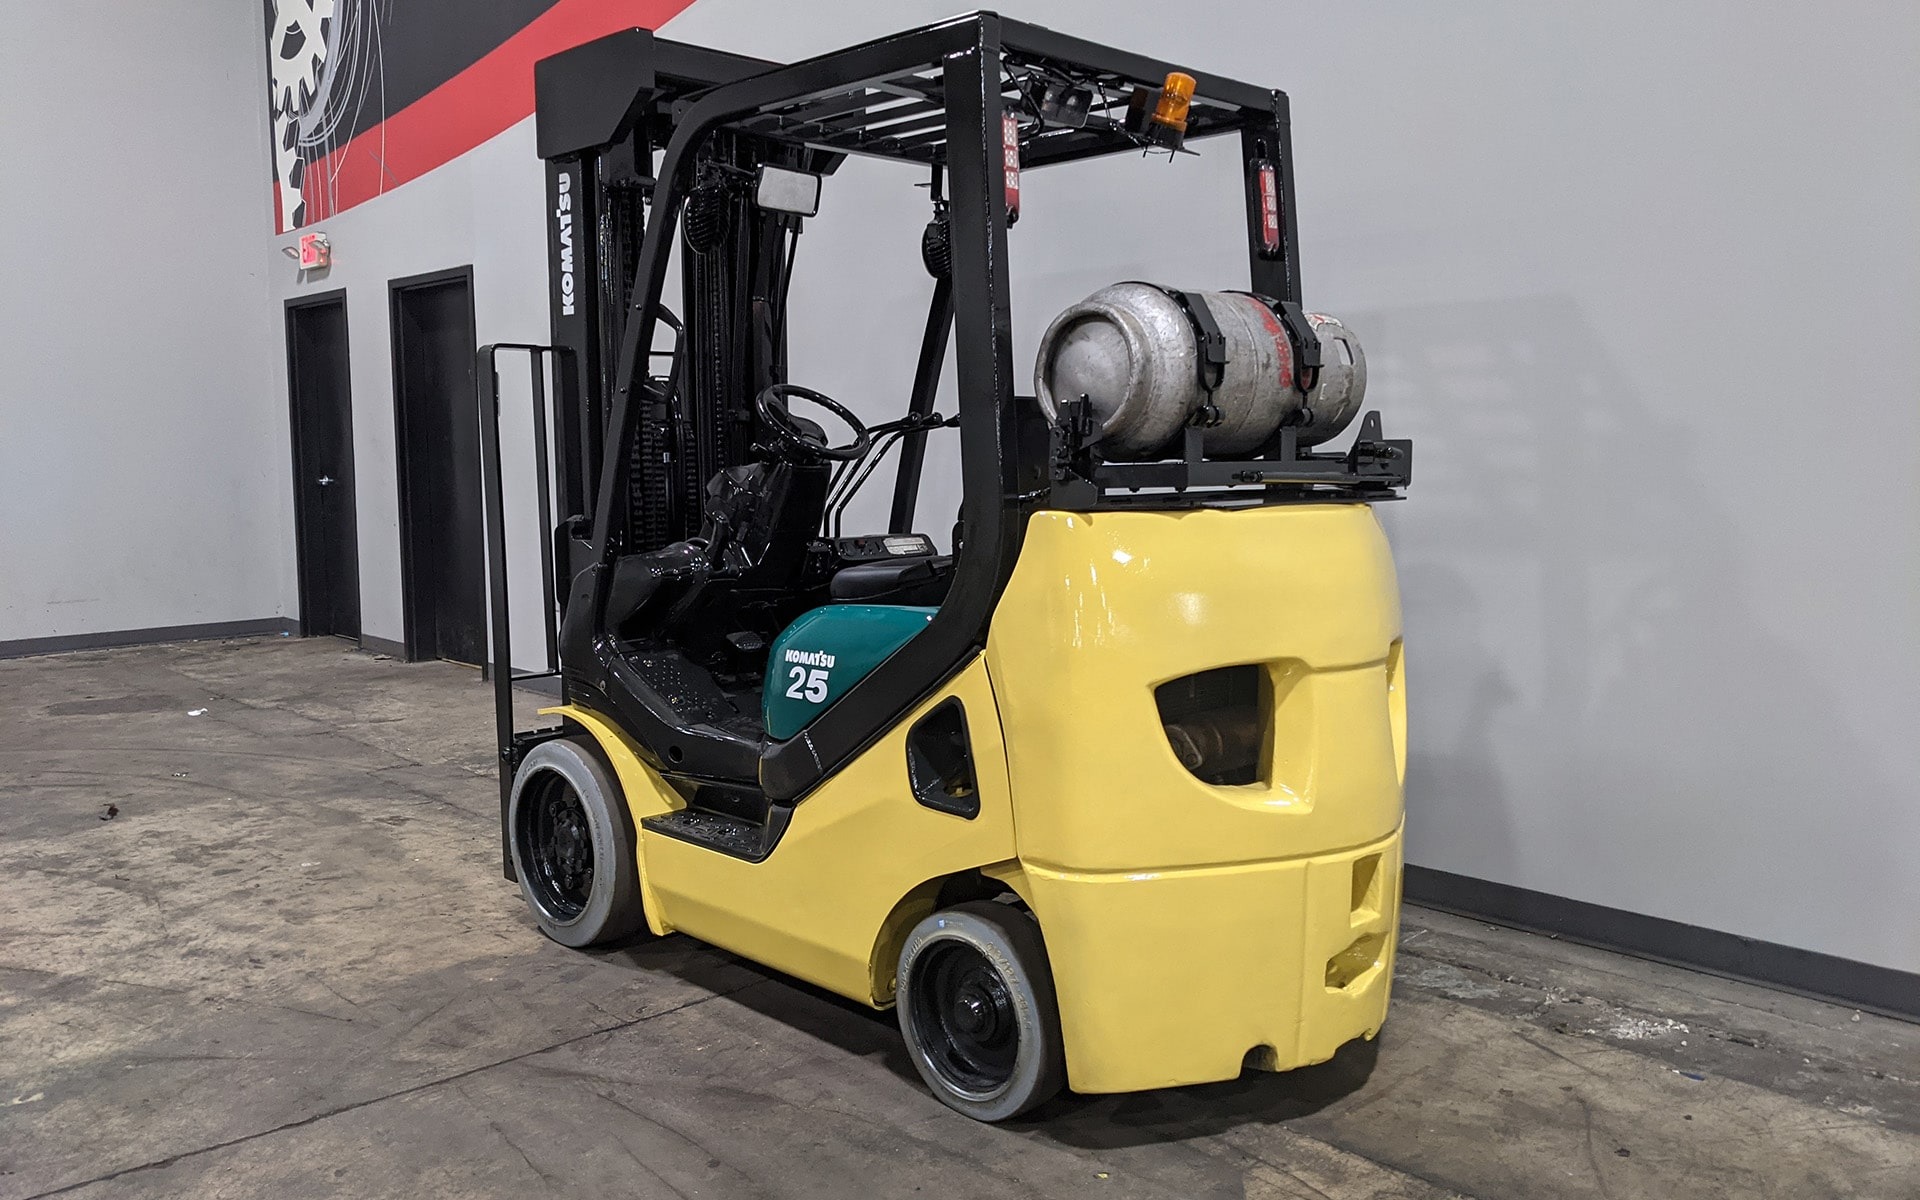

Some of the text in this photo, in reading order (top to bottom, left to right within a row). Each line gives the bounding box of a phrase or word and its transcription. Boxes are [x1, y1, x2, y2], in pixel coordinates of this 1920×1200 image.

[556, 172, 575, 316] KOMATSU
[785, 649, 836, 668] KOMATSU
[786, 665, 829, 703] 25
